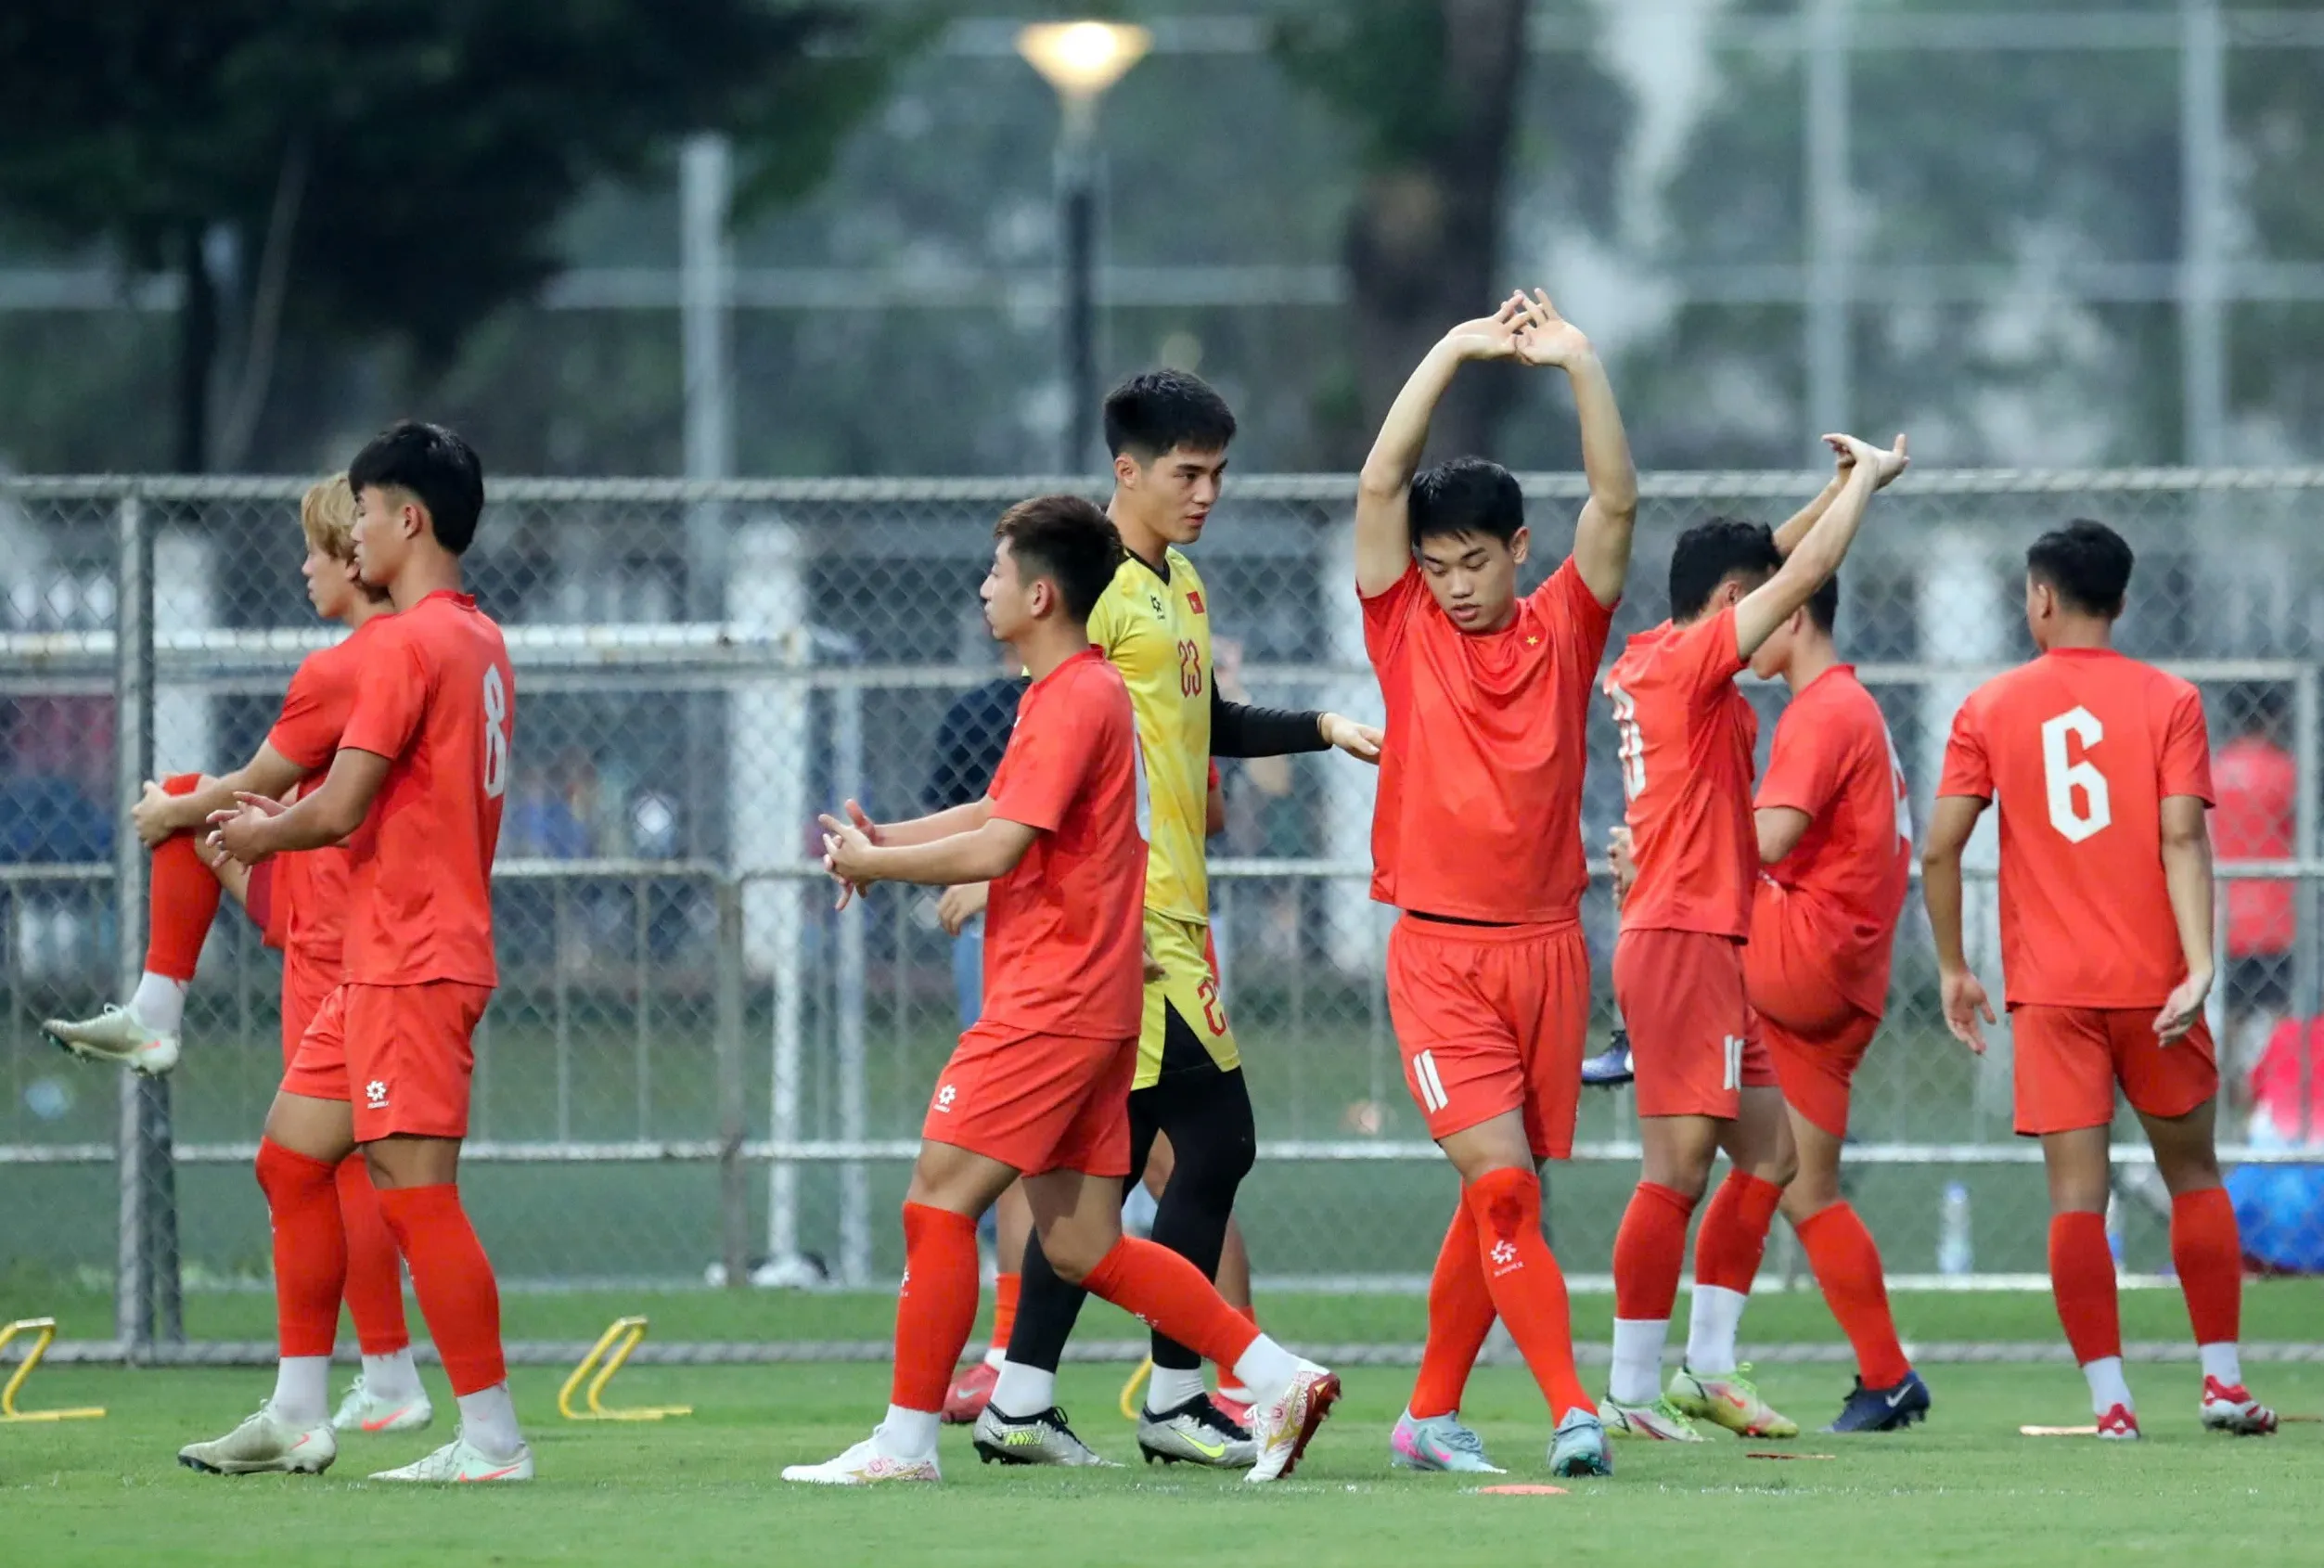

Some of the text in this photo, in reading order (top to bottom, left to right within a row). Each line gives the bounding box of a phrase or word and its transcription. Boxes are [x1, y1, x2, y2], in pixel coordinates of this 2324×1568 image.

[1177, 638, 1201, 698] 23
[482, 662, 507, 799] 8
[2042, 704, 2112, 844] 6
[1412, 1048, 1449, 1114] 11
